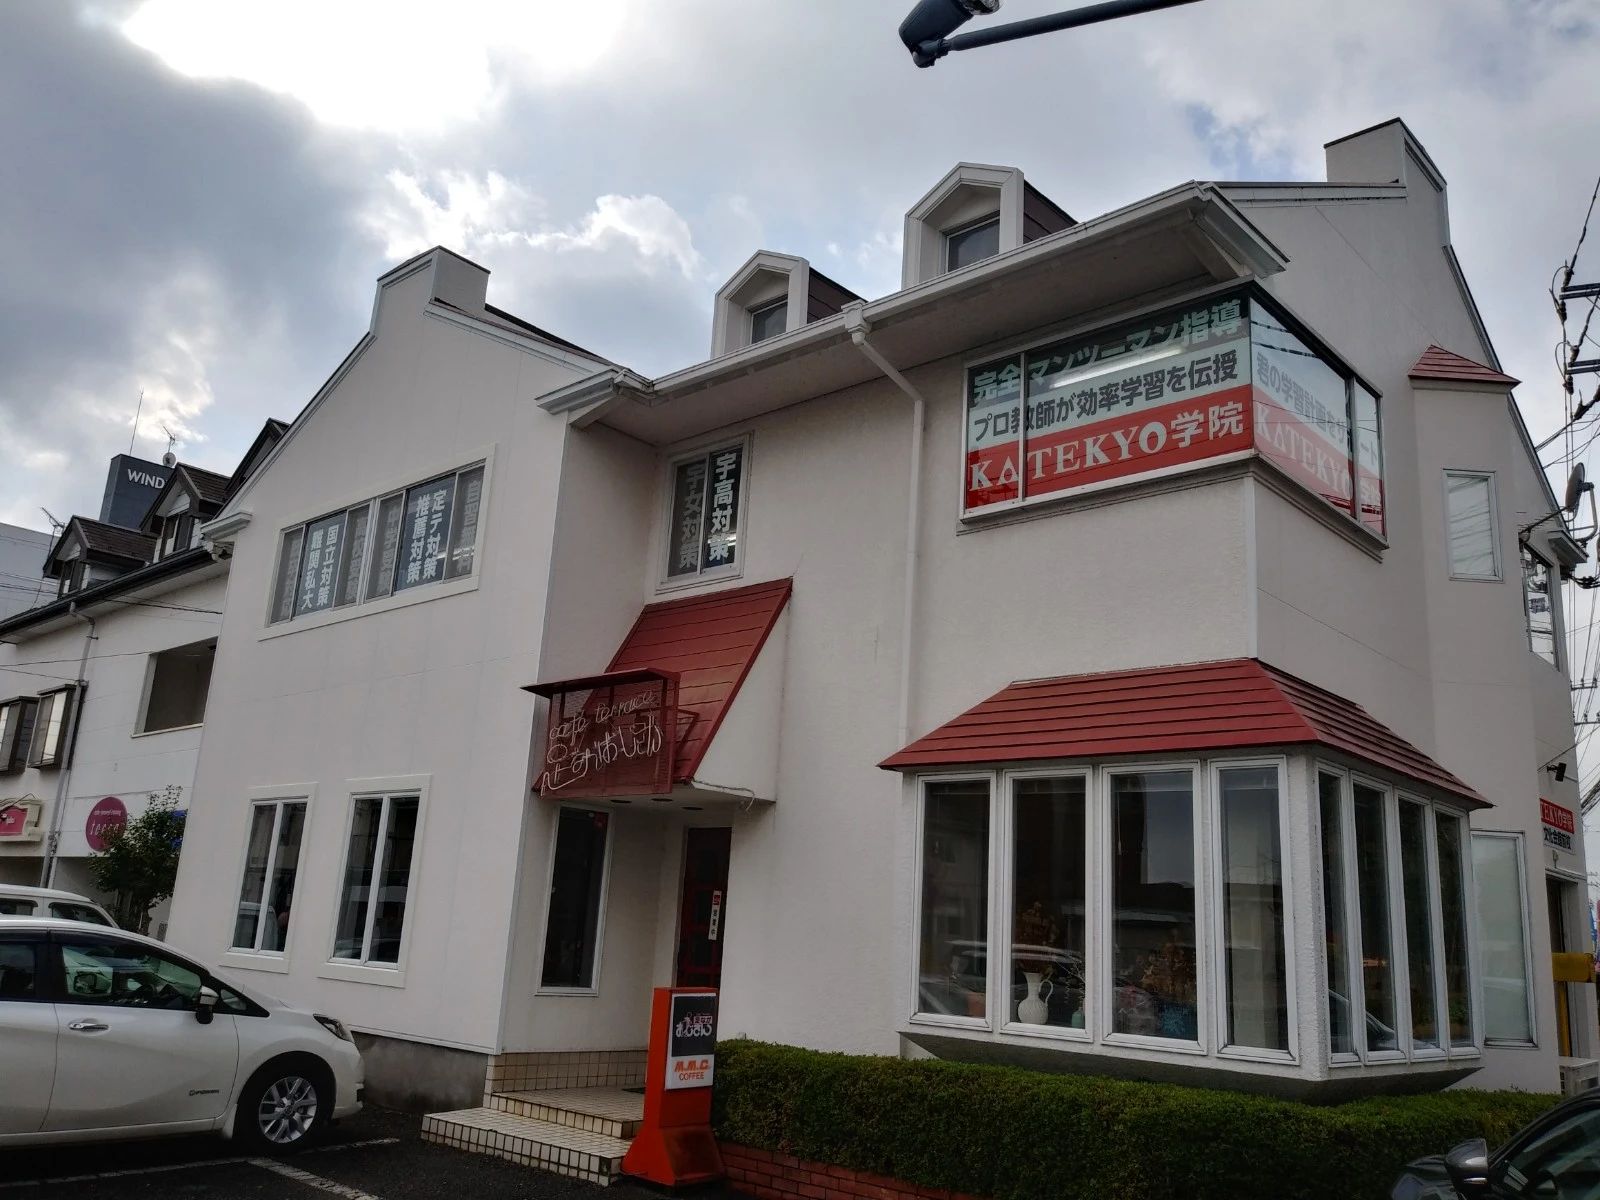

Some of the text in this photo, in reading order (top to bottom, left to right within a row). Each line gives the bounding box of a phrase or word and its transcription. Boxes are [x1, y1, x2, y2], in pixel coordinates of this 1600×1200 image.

[974, 300, 1241, 399] 完全マンツーマン指導
[974, 349, 1238, 442] プロ教師が効率学習を伝授
[969, 401, 1243, 491] KATEKYO学院
[422, 489, 447, 580] 定テ対策
[708, 453, 737, 561] 宇高対策
[316, 524, 340, 607] 国立対策
[678, 1072, 705, 1081] COFFEE
